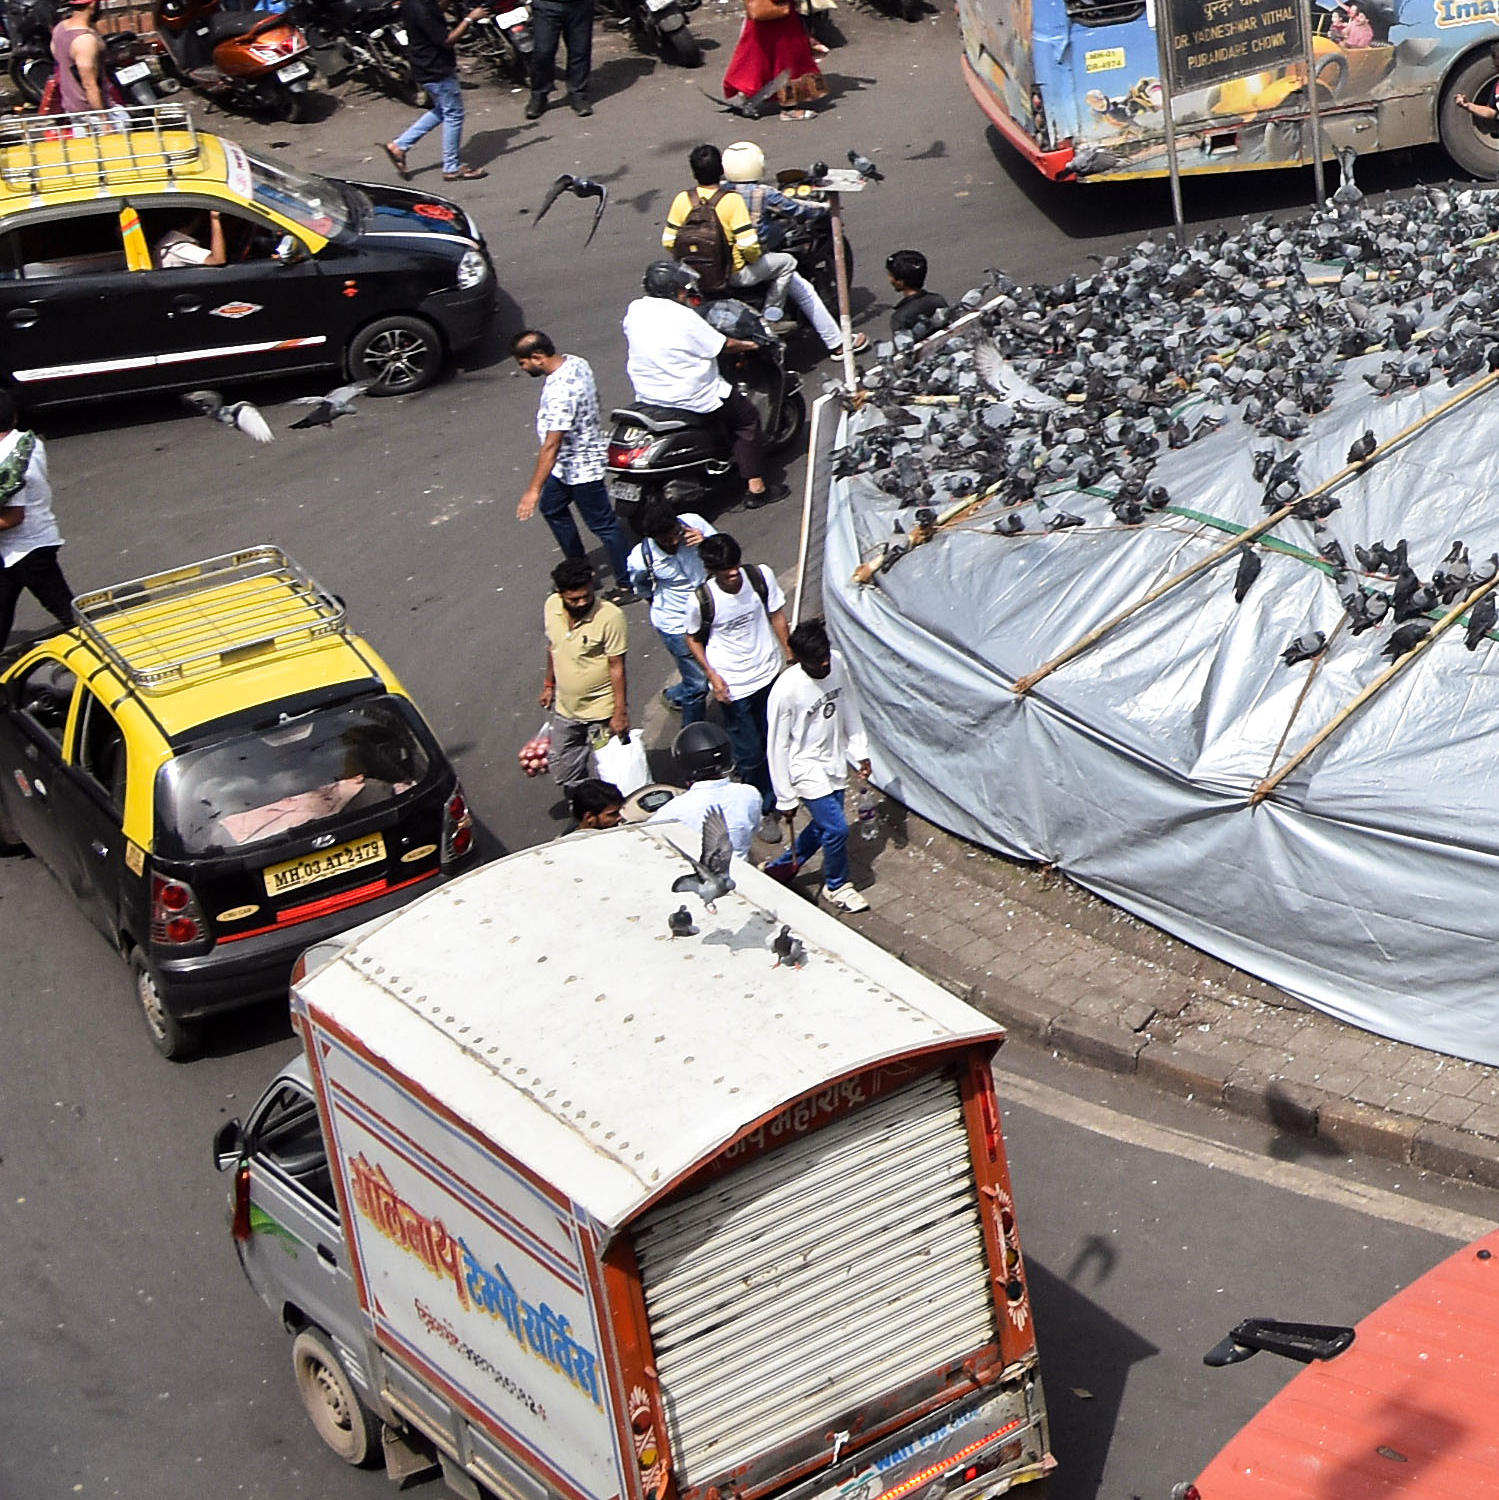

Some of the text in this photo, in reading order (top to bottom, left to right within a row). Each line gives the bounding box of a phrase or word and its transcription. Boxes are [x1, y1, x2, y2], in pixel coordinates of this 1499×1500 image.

[1193, 16, 1257, 44] YADNESHWAR
[1261, 6, 1296, 27] VITHAL
[1188, 31, 1286, 70] PURANDARE CHOWK
[273, 865, 300, 887] MH
[304, 859, 322, 876] 03
[326, 852, 344, 870] AT
[345, 842, 380, 862] 2479
[770, 1076, 867, 1137] महाराष्ट्र
[457, 1235, 528, 1353] टेम्पो
[520, 1301, 604, 1414] सर्विस
[874, 1443, 916, 1471] WAIT
[919, 1426, 949, 1448] FOR
